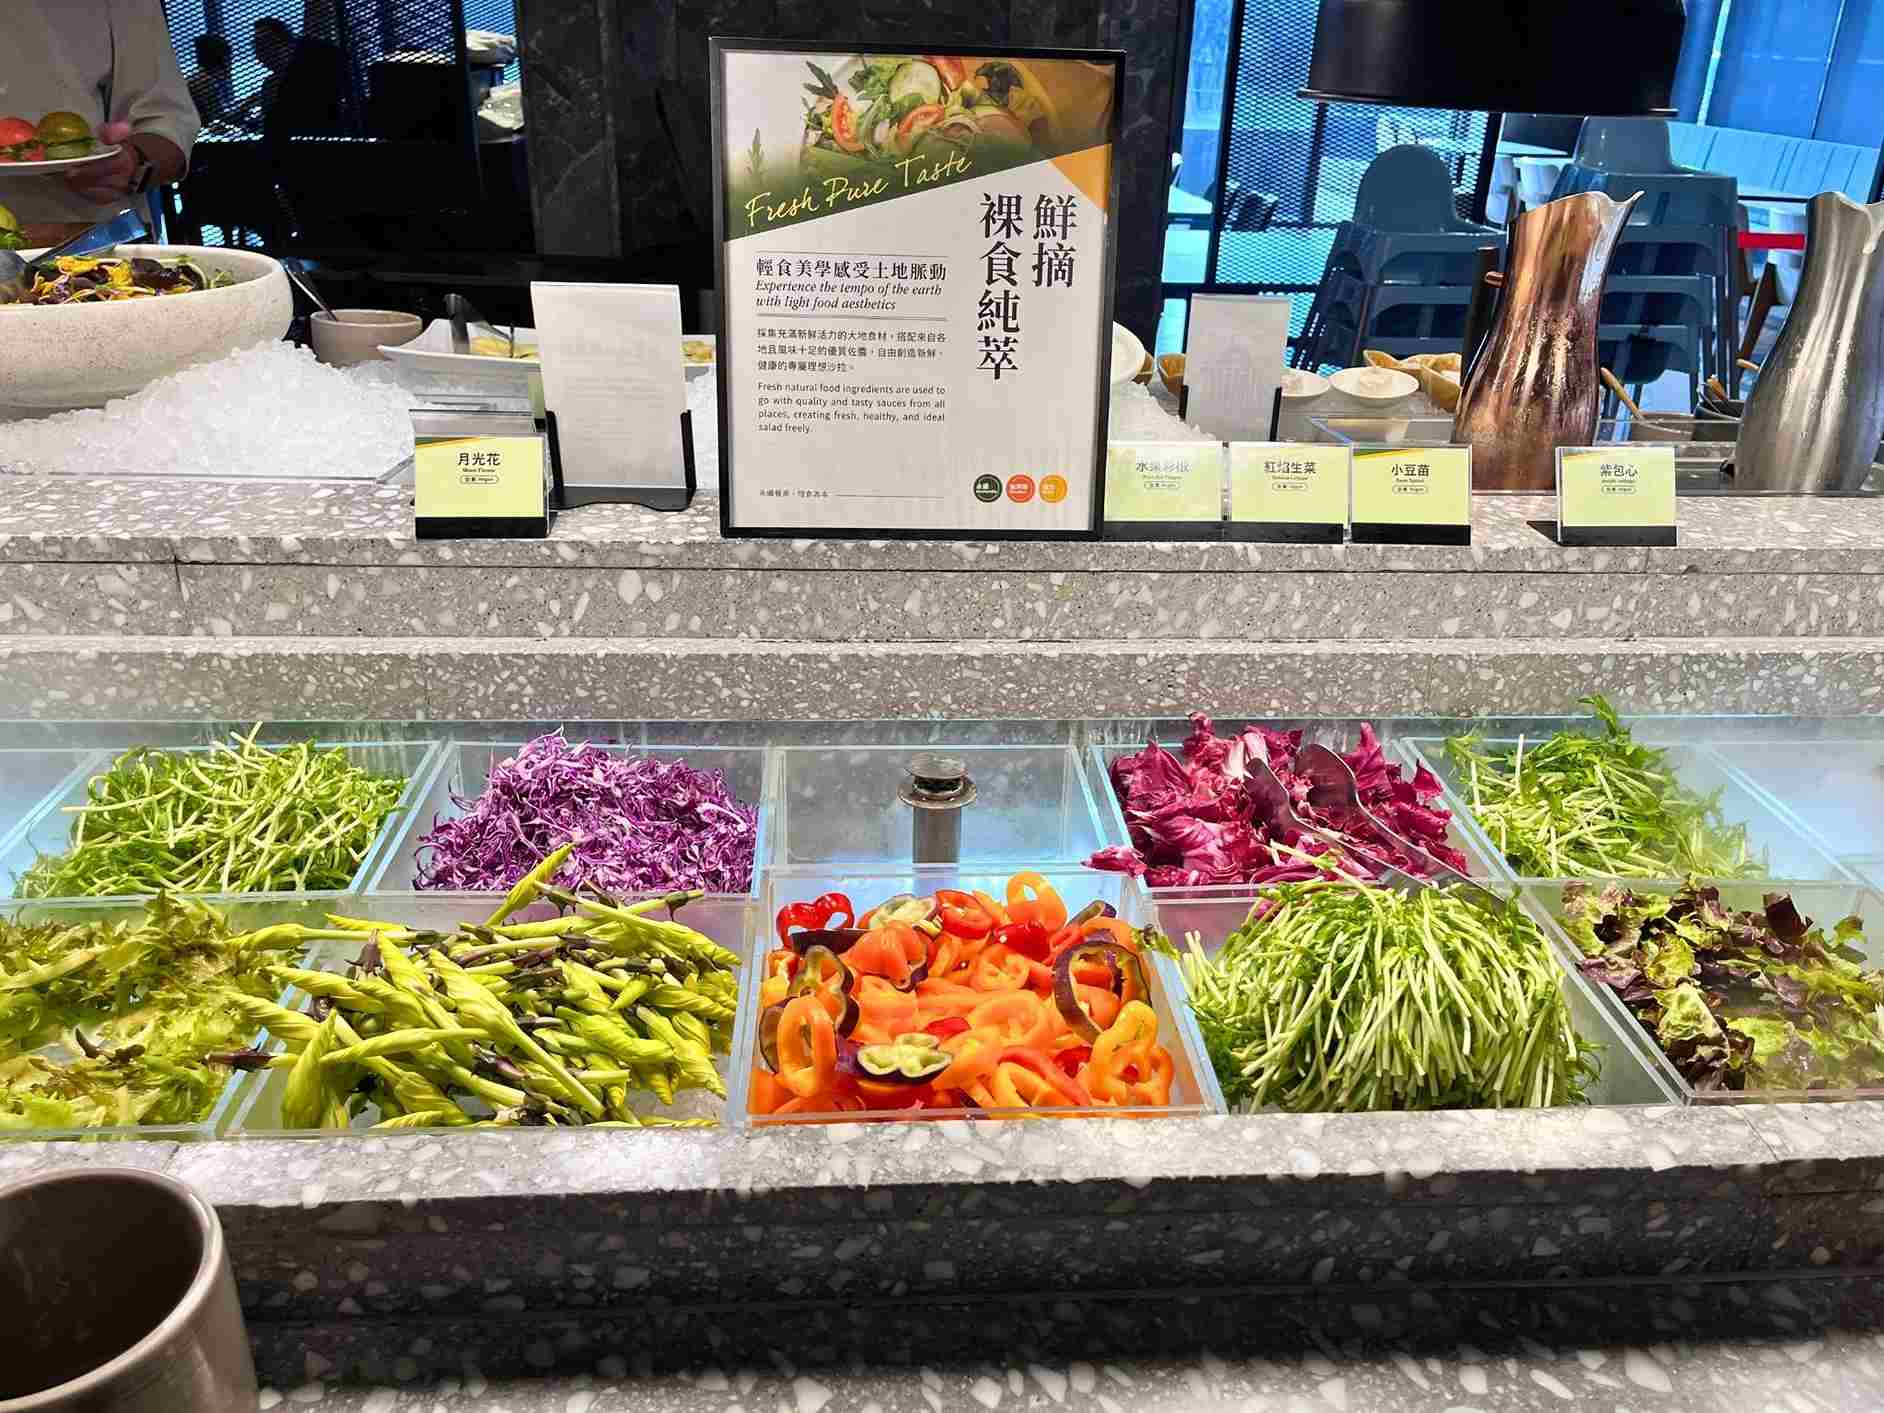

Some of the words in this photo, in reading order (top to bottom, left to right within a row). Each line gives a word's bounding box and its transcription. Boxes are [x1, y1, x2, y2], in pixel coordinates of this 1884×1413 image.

[745, 188, 819, 226] Fresh
[823, 176, 888, 207] Pure
[895, 151, 972, 187] Taste
[1032, 193, 1077, 288] 鮮摘
[757, 259, 946, 280] 輕食美學感受土地脈動
[756, 280, 816, 294] Experience
[820, 281, 837, 293] the
[840, 283, 874, 297] tempo
[878, 283, 891, 297] of
[892, 283, 909, 295] the
[912, 285, 942, 296] earth
[977, 192, 1024, 380] 裸食純萃
[756, 296, 781, 307] with
[784, 296, 809, 310] light
[812, 297, 839, 311] food
[842, 298, 896, 310] aesthetics
[758, 382, 782, 391] Fresh
[785, 384, 817, 392] natural
[820, 384, 840, 392] food
[843, 384, 893, 395] ingredients
[896, 386, 911, 394] are
[913, 385, 933, 394] used
[759, 398, 769, 406] go
[774, 397, 793, 405] with
[795, 397, 828, 407] quality
[851, 399, 873, 408] tasty
[877, 400, 907, 408] sauces
[910, 399, 931, 408] from
[935, 399, 945, 408] all
[793, 411, 830, 421] creating
[864, 412, 899, 422] healthy,
[924, 412, 945, 421] ideal
[457, 452, 501, 466] 月光花
[1391, 463, 1430, 477] 小豆苗
